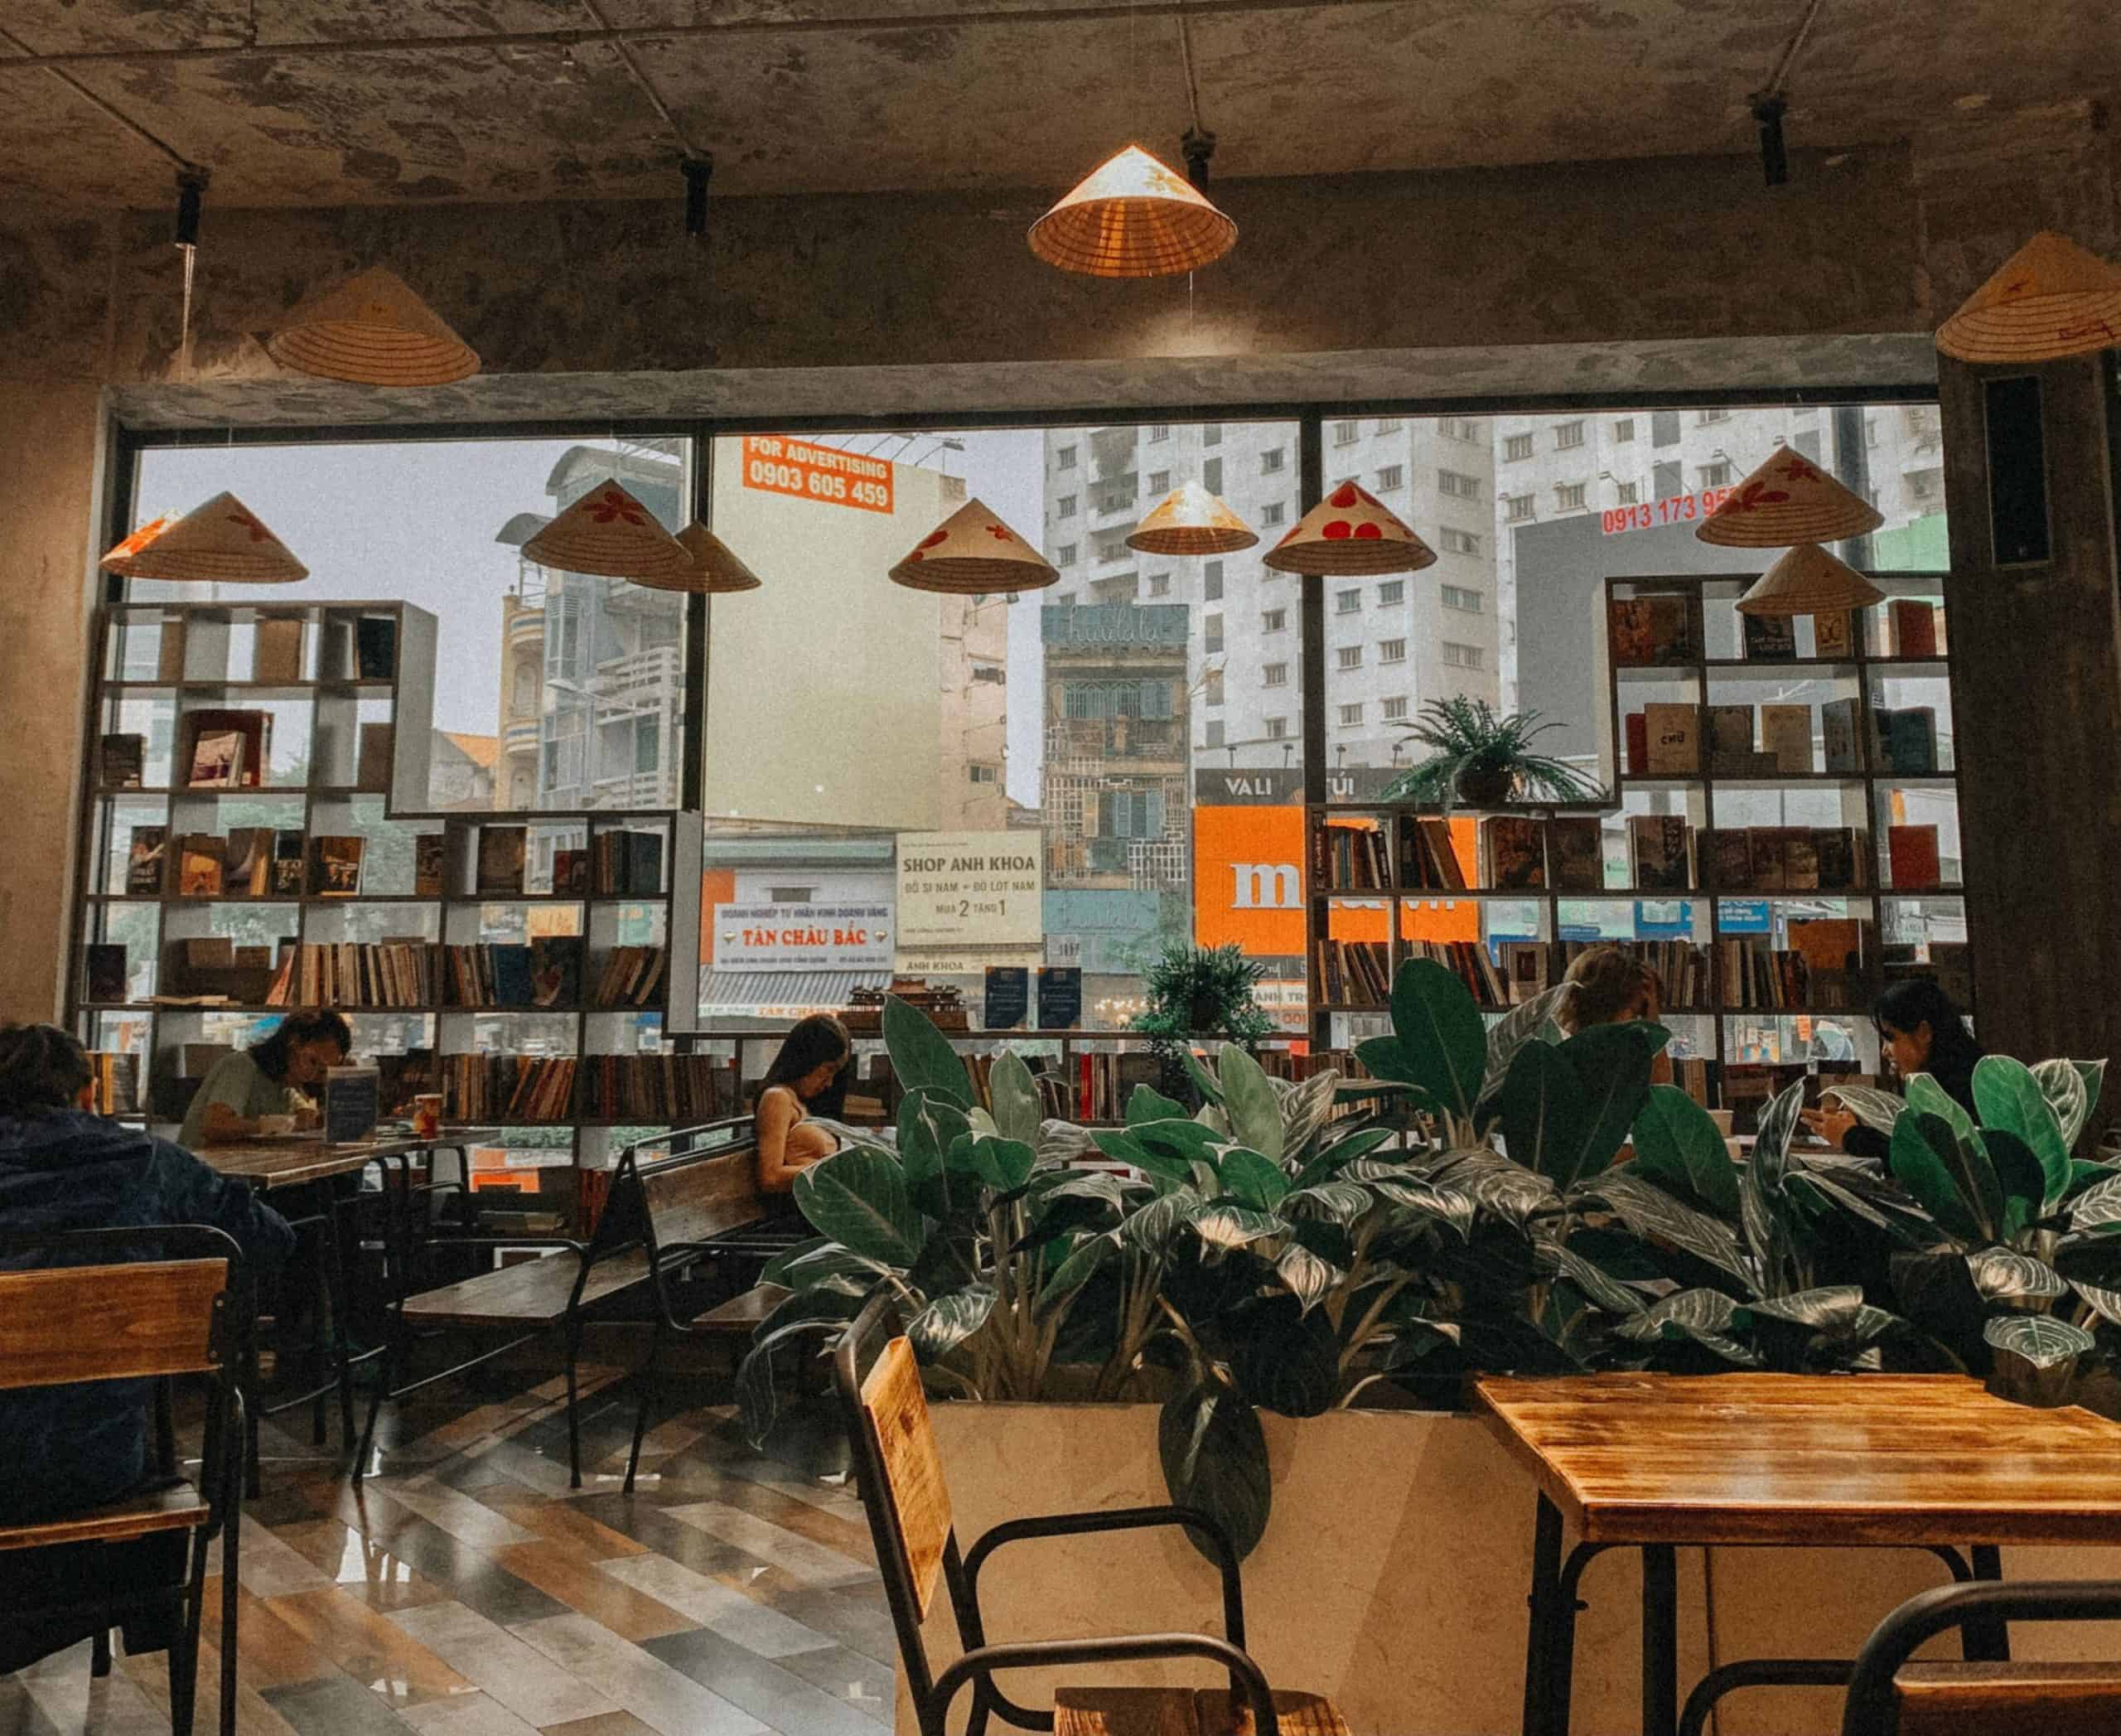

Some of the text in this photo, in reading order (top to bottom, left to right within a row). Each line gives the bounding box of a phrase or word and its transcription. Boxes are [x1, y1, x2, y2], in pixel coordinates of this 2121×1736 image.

[749, 437, 887, 479] FOR ADVERTISING
[750, 461, 888, 507] 0903 605 459
[1602, 503, 1652, 533] 0913
[1658, 494, 1696, 524] 173
[1326, 771, 1355, 795] ÚI
[903, 856, 1035, 873] SHOP ANH KHOA
[935, 883, 959, 893] NAM
[1012, 881, 1035, 891] NAM
[959, 899, 969, 917] 2
[998, 899, 1006, 916] 1
[742, 924, 777, 946] TÂN
[781, 924, 829, 946] CHÂU
[906, 961, 964, 971] ANH KHOA
